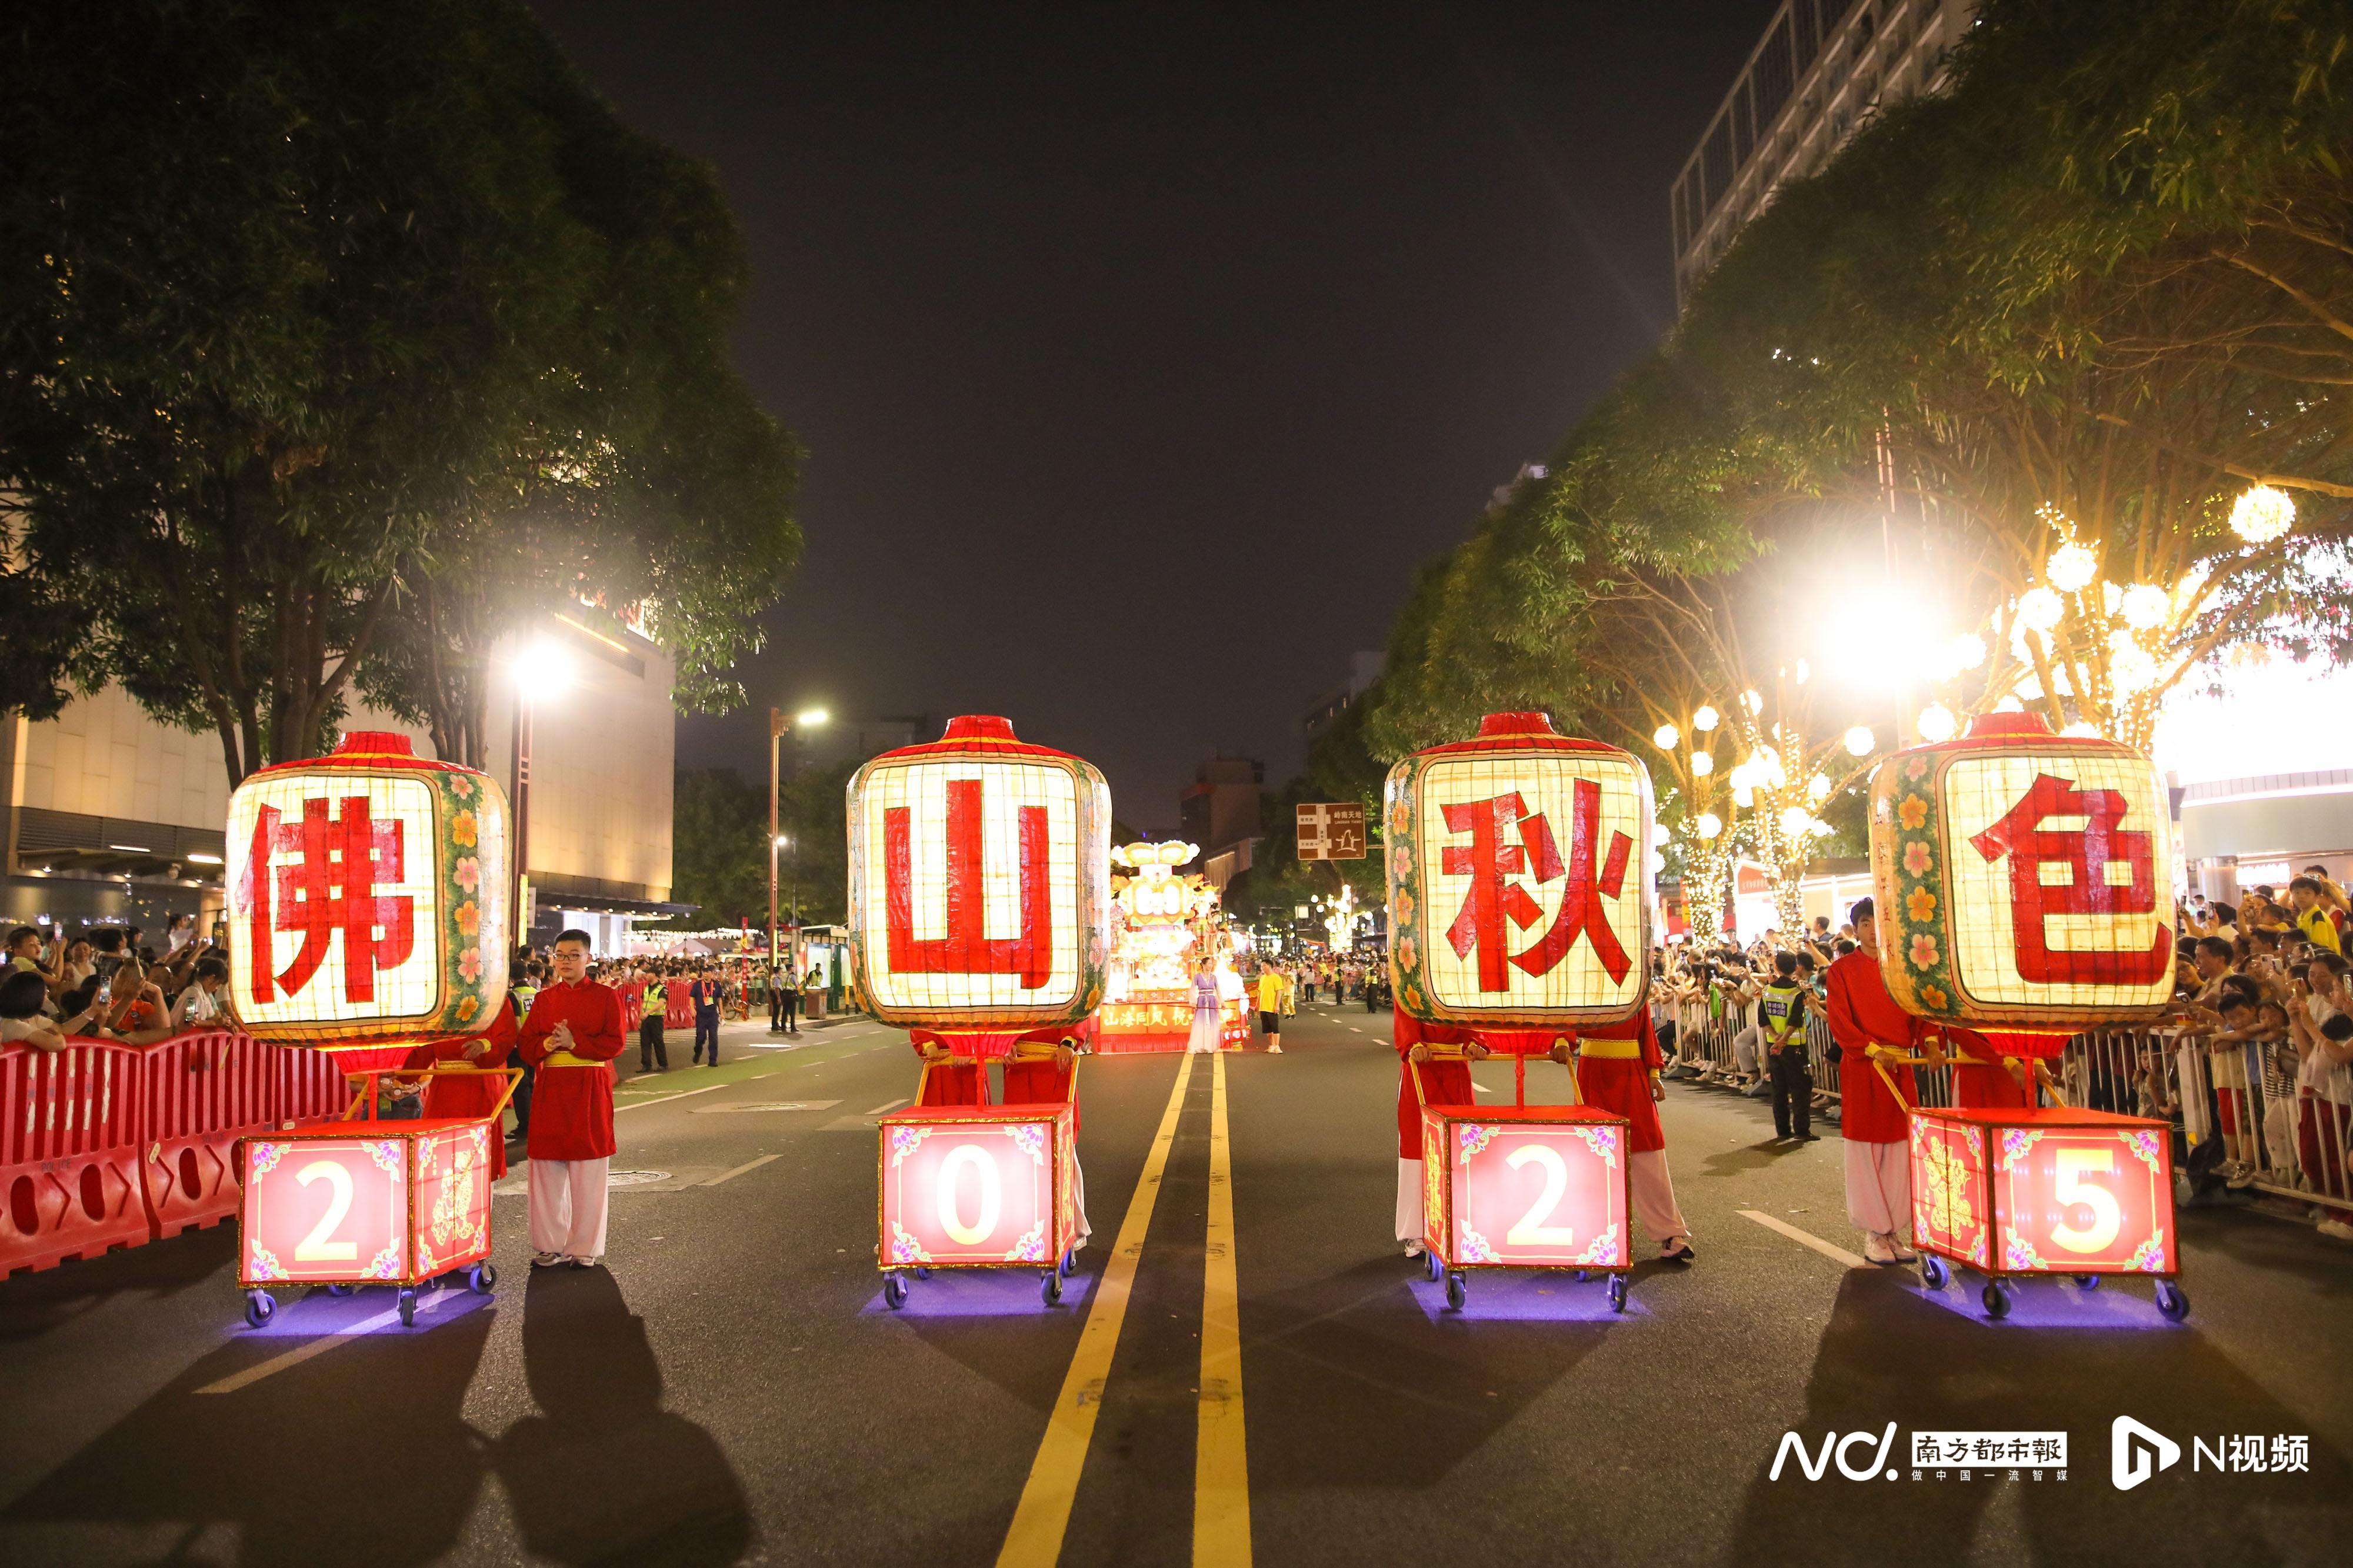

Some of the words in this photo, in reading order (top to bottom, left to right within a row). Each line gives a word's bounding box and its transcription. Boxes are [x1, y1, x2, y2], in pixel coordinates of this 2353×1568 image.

[1334, 811, 1362, 819] 岭南天地
[235, 796, 414, 1005] 佛
[884, 779, 1052, 989] 山
[1439, 778, 1633, 992] 秋
[1968, 772, 2172, 985] 色
[1104, 1010, 1168, 1027] 山海同风
[294, 1160, 358, 1261] 2
[936, 1144, 1001, 1245] 0
[1505, 1144, 1574, 1246] 2
[2050, 1149, 2121, 1253] 5
